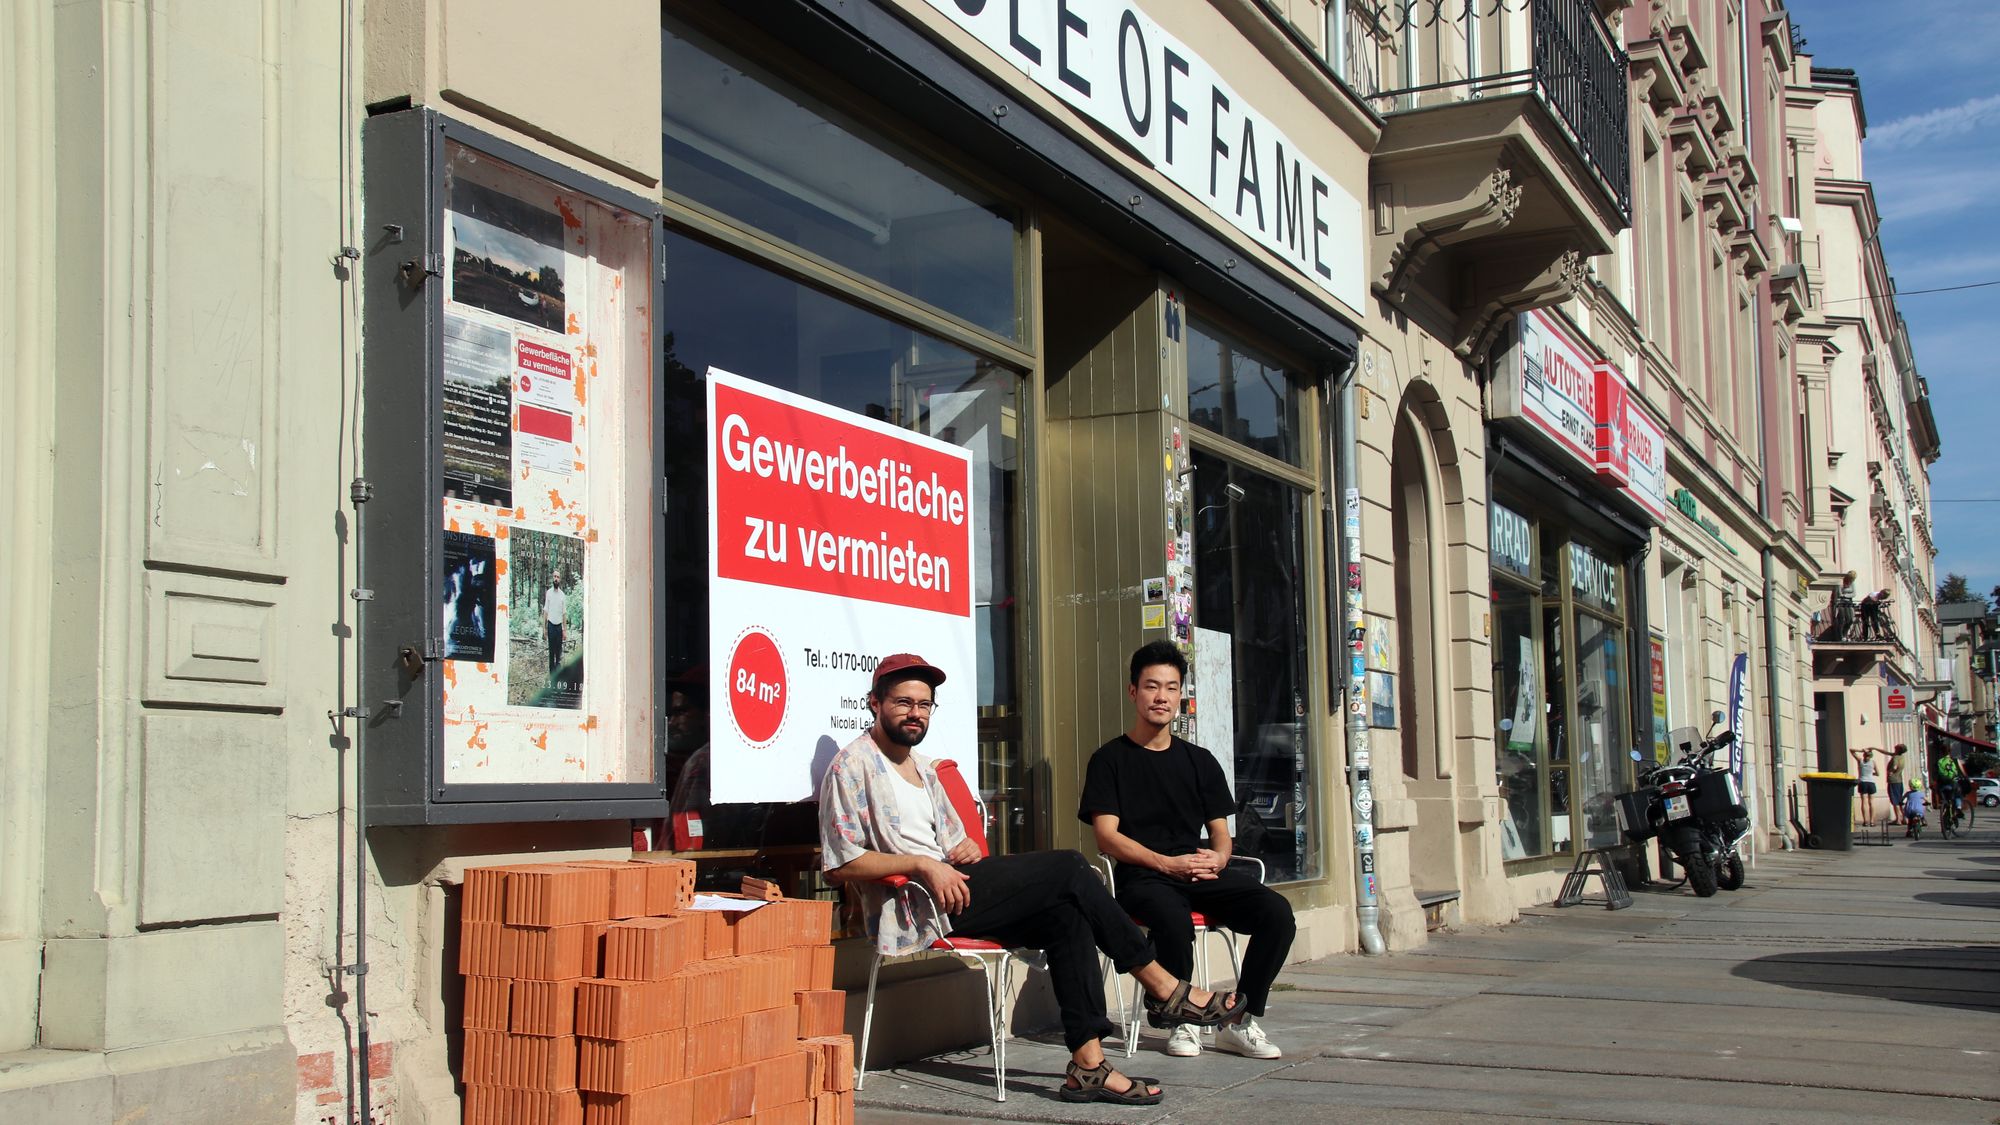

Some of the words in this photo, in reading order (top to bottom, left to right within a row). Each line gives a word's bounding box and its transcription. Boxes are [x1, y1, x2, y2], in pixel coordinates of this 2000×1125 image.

[949, 0, 1092, 98] LE
[1118, 8, 1190, 166] OF
[1210, 83, 1332, 281] FAME
[519, 342, 571, 366] Gewerbefläche
[522, 358, 532, 367] zu
[533, 361, 567, 377] vermieten
[1543, 344, 1595, 418] AUTOTEILE
[1561, 409, 1579, 437] ERNST
[721, 413, 965, 526] Gewerbefläche
[744, 516, 787, 563] zu
[798, 526, 951, 593] vermieten
[1569, 542, 1617, 606] SERVICE
[804, 647, 828, 668] Tel.:
[831, 651, 879, 673] 0170-000
[736, 668, 757, 695] 84
[759, 681, 781, 704] m²
[840, 696, 858, 711] Inho
[830, 715, 858, 731] Nicolai
